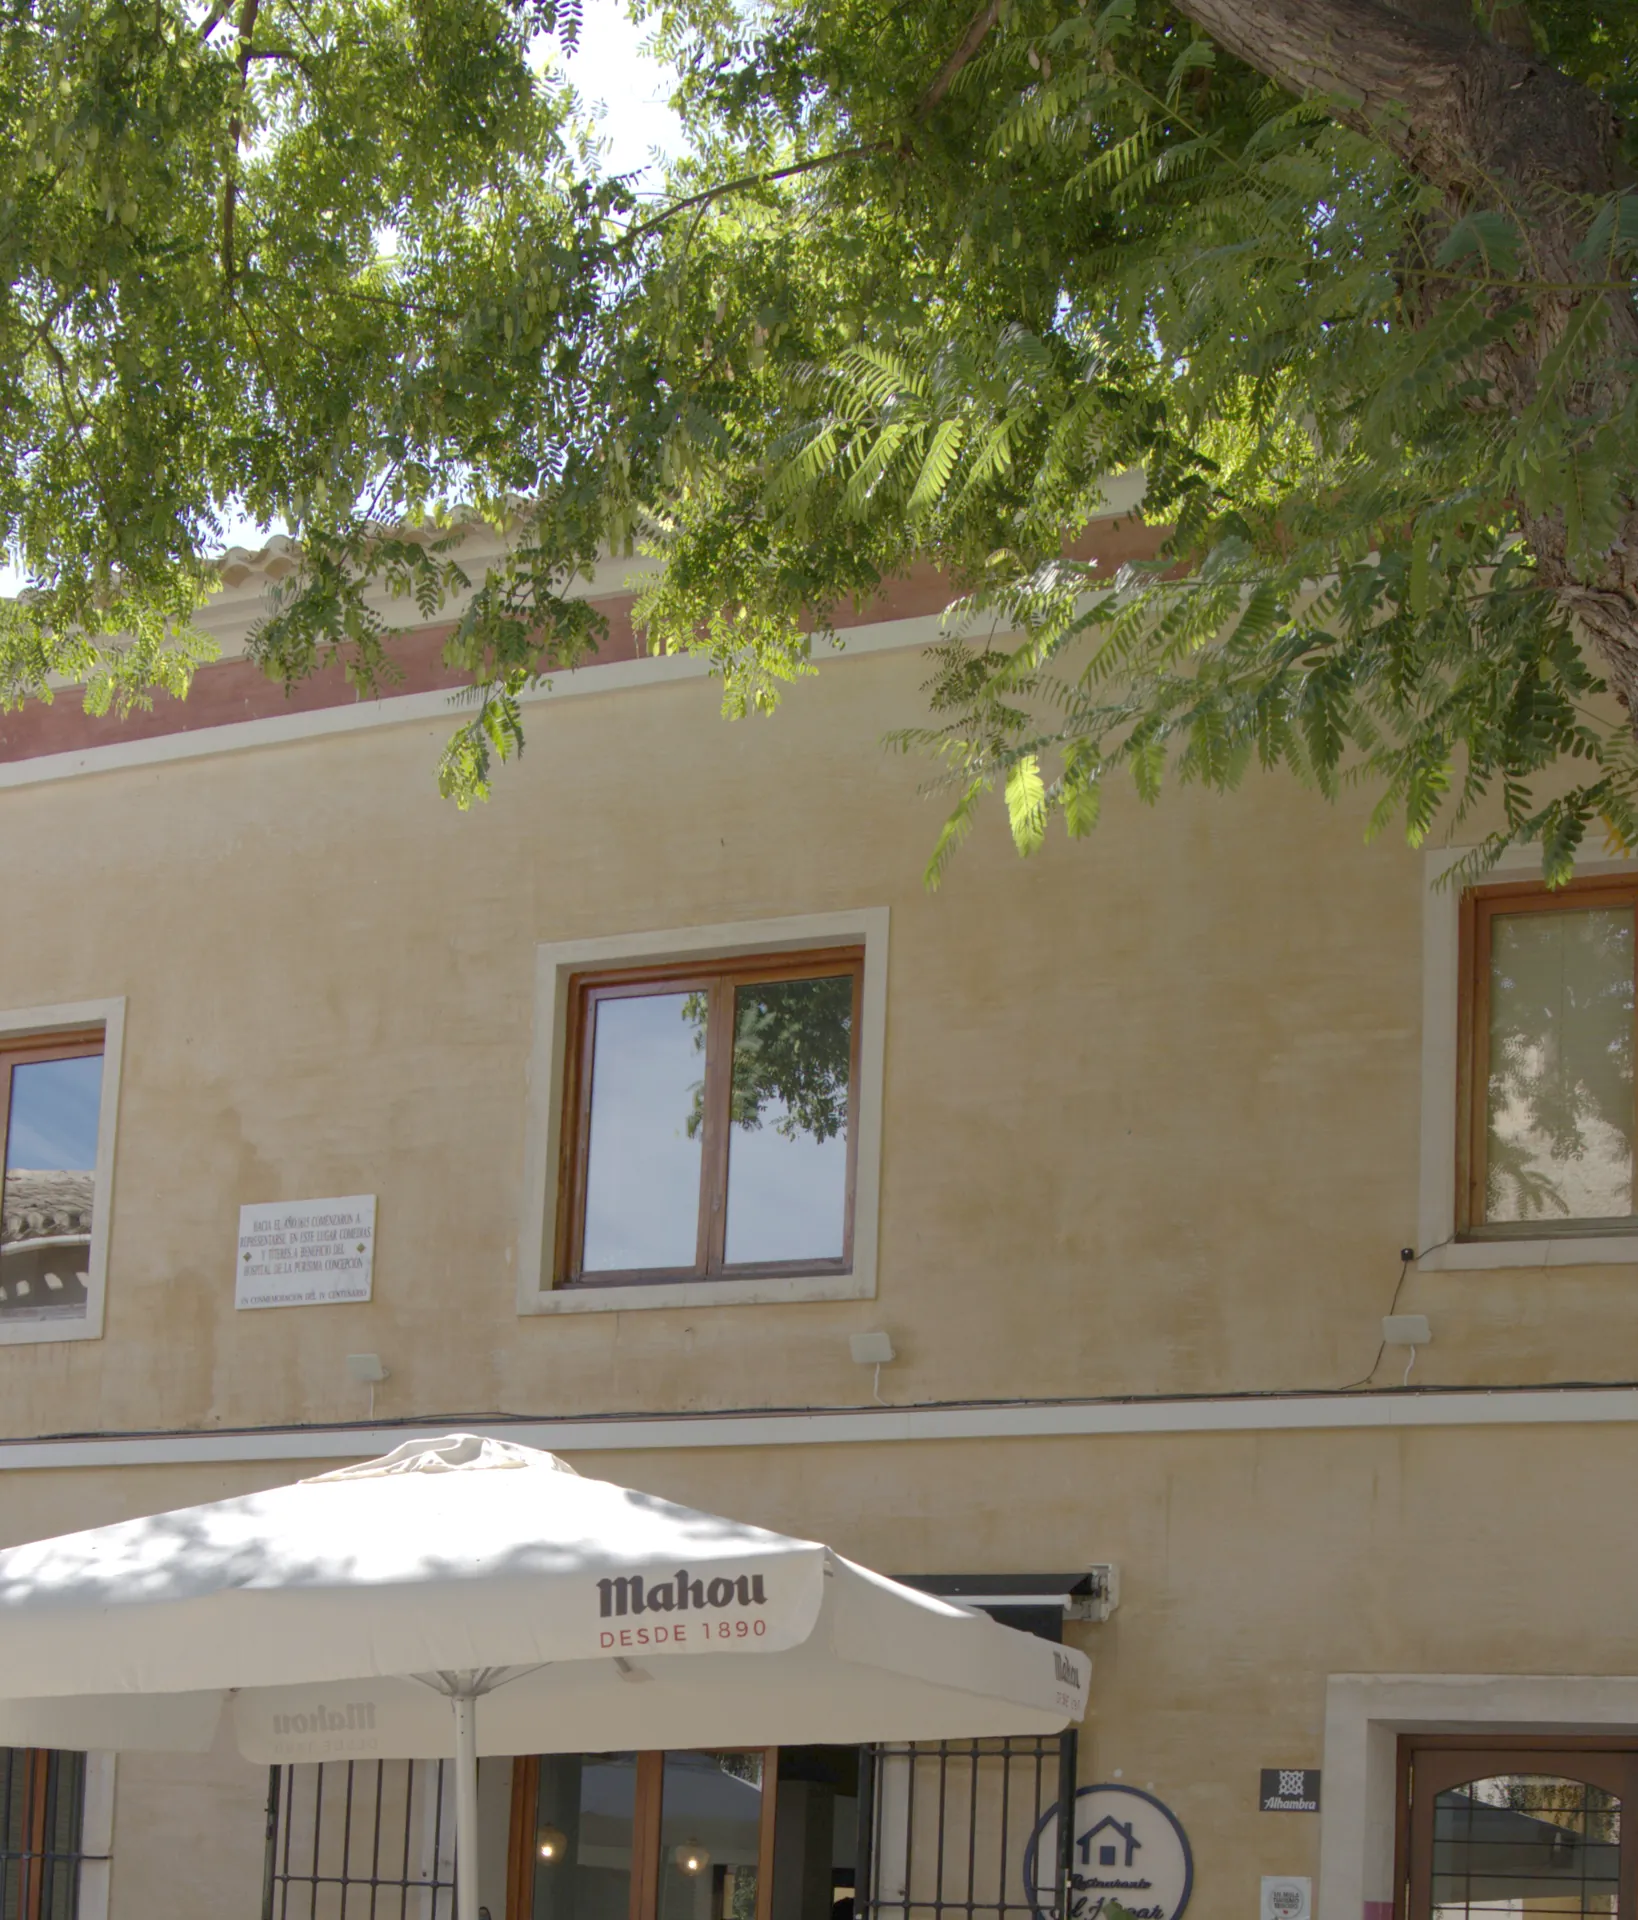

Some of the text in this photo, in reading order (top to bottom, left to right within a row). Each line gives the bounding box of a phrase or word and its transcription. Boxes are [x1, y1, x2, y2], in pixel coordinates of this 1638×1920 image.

[274, 1219, 281, 1231] EL
[311, 1214, 353, 1227] COMENZARON
[289, 1232, 298, 1244] EN
[300, 1231, 315, 1243] ESTE
[317, 1229, 337, 1242] LUGAR
[339, 1226, 371, 1240] COMEDIAS
[300, 1245, 332, 1258] BENEFICIO
[333, 1243, 345, 1255] DEL
[243, 1264, 271, 1276] HOSPITAL
[284, 1262, 293, 1273] LA
[328, 1288, 367, 1300] CENTENARIO
[596, 1569, 768, 1618] Mahou
[600, 1619, 766, 1648] DESDE 1890
[1264, 1797, 1316, 1810] Alhambra
